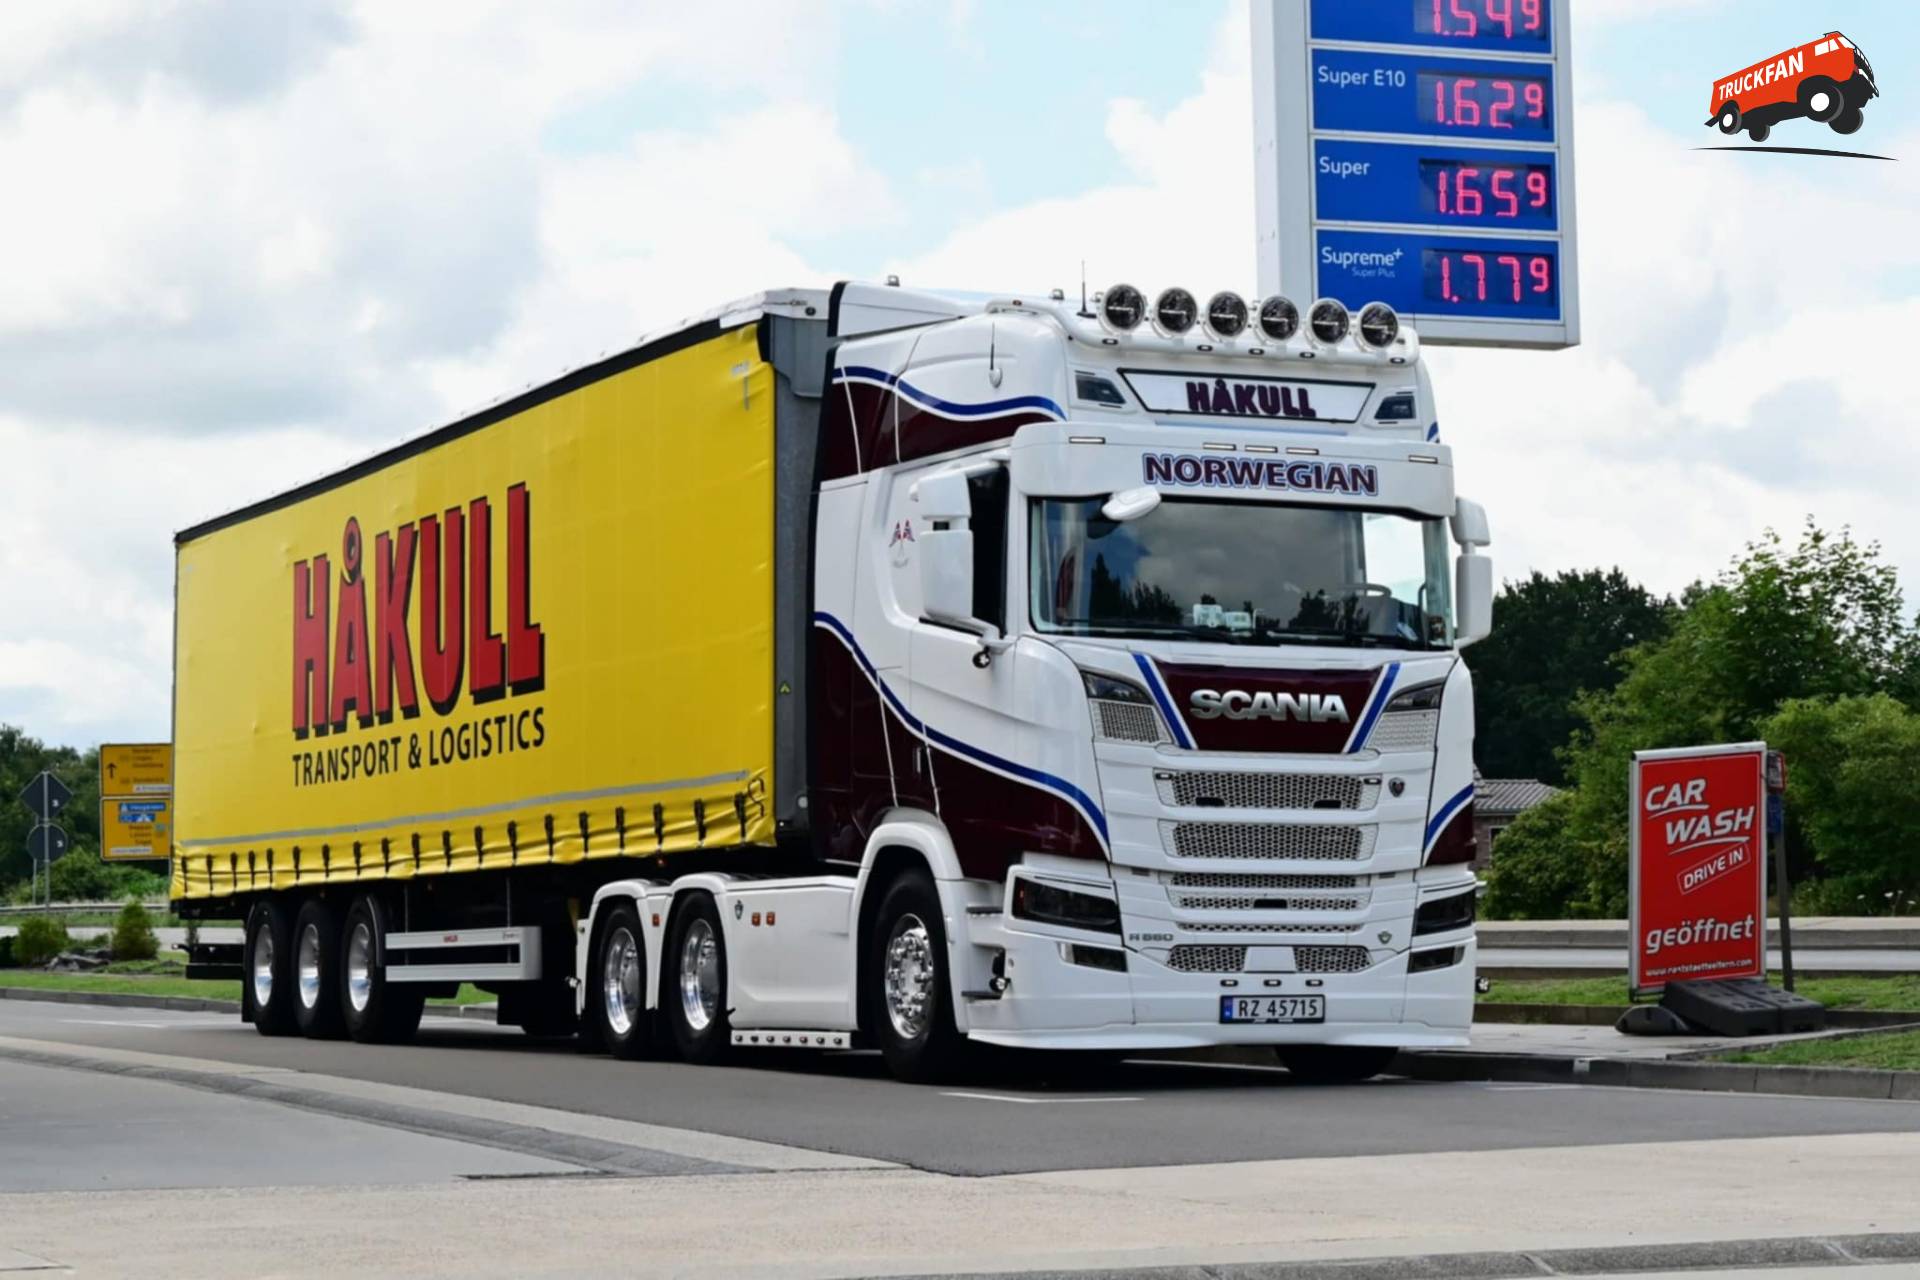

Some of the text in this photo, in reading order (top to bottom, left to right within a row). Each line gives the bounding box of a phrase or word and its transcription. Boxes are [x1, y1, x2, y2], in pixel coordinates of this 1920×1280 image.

[1318, 65, 1406, 89] Super E10
[1319, 157, 1370, 179] Super
[1351, 266, 1396, 278] Super Plus
[1185, 378, 1316, 418] HÅKULL
[1142, 452, 1379, 496] NORWEGIAN
[292, 481, 545, 741] HÅKULL
[1189, 689, 1350, 723] SCANIA
[292, 707, 545, 787] TRANSPORT & LOGISTICS
[1645, 778, 1707, 812] CAR
[1665, 806, 1755, 845] WASH
[1683, 847, 1744, 890] DRIVE IN
[1646, 914, 1755, 954] geöffnet
[1239, 999, 1318, 1017] RZ 45715
